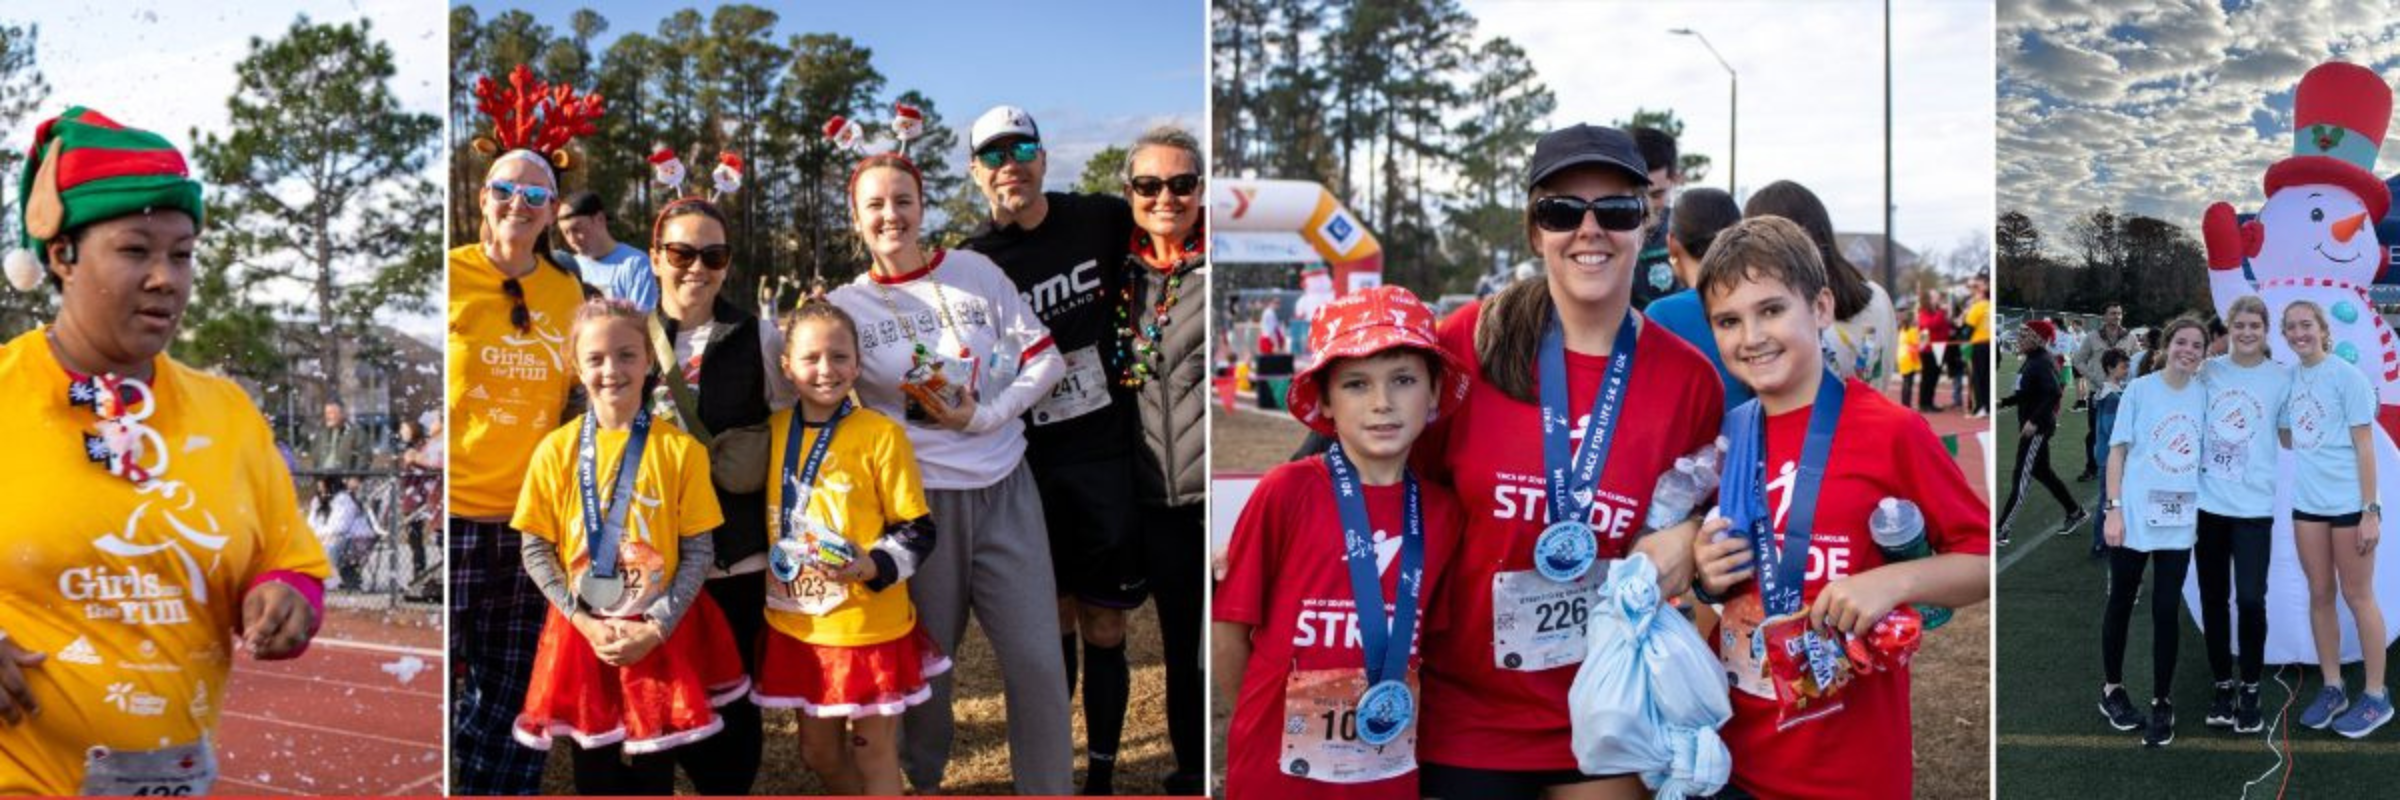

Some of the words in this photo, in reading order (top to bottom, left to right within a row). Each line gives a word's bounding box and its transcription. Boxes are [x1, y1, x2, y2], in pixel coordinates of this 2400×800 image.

[481, 345, 535, 366] Girls
[508, 367, 548, 381] run
[1582, 452, 1599, 481] RACE
[1592, 429, 1606, 451] FOR
[1614, 353, 1627, 374] 10K
[1340, 475, 1354, 498] 10K
[1493, 484, 1636, 539] STDE
[58, 566, 160, 600] Girls
[118, 599, 192, 625] run
[1535, 597, 1588, 633] 226
[1321, 709, 1357, 741] 10
